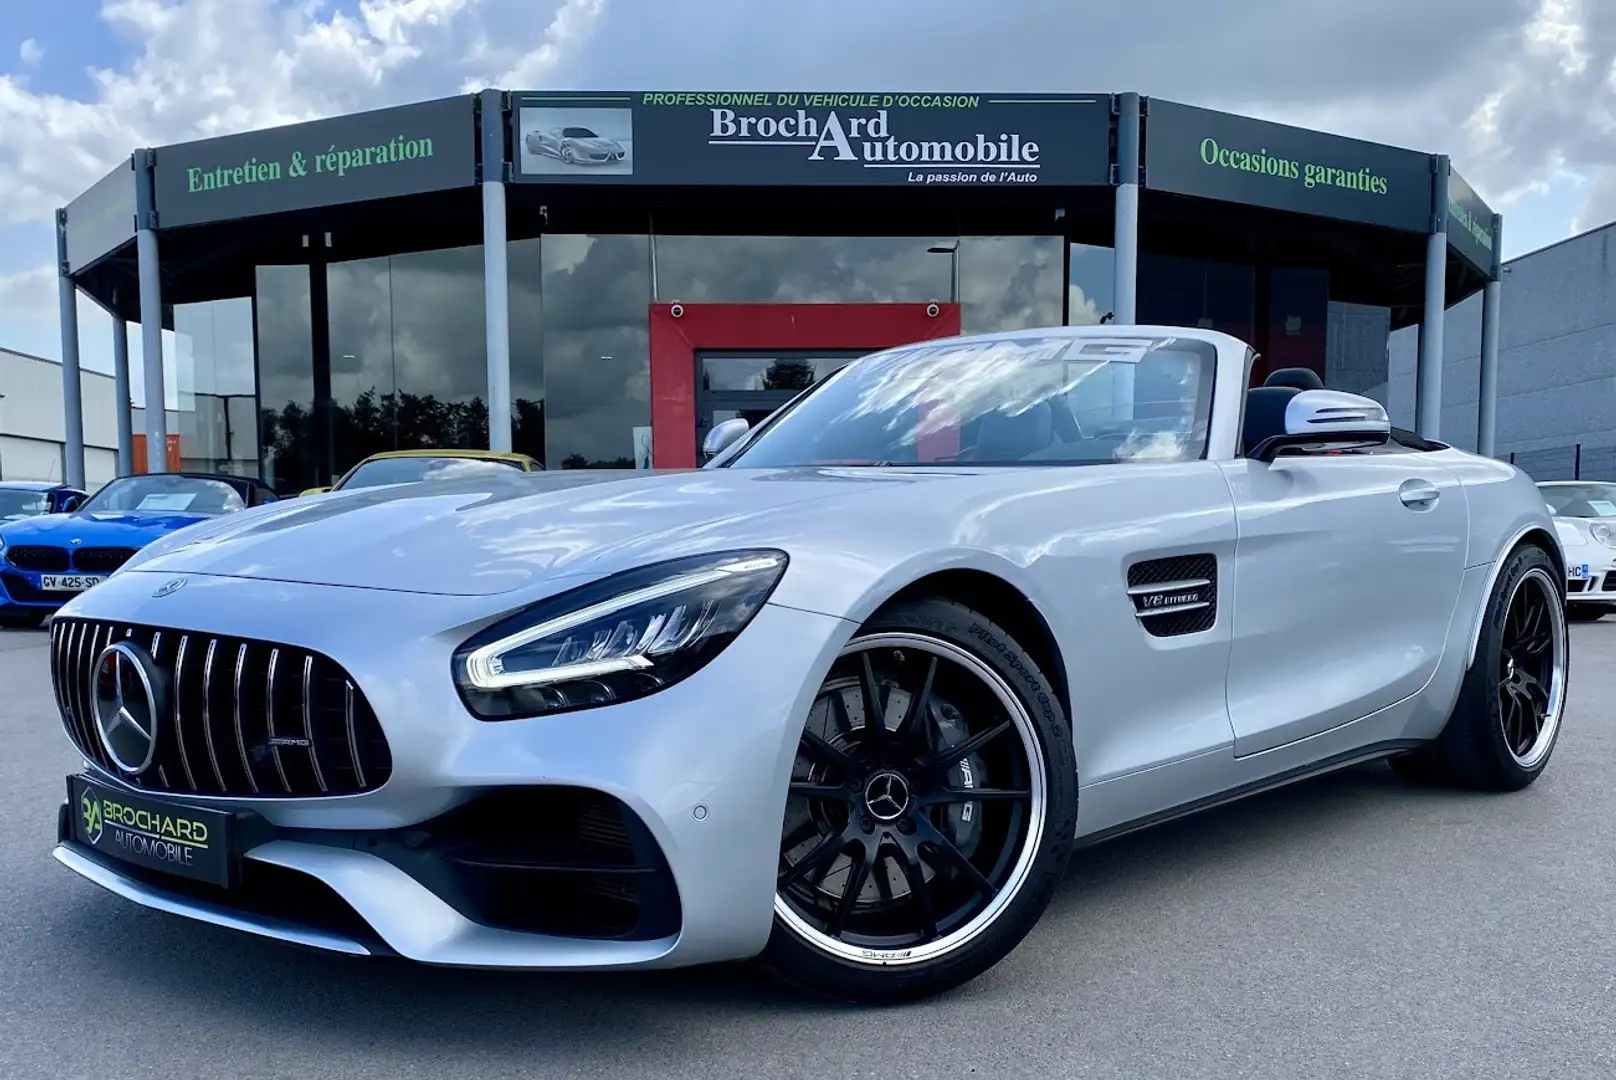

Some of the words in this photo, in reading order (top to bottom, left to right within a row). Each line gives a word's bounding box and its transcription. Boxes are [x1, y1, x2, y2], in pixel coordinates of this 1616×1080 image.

[642, 93, 773, 106] PROFESSIONNEL
[776, 94, 800, 107] DU
[803, 94, 879, 107] VEHICULE
[882, 95, 980, 108] D'OCCASION
[186, 157, 282, 194] Entretien
[288, 151, 309, 178] &
[314, 134, 434, 177] réparation
[907, 172, 924, 183] La
[926, 171, 977, 185] passion
[980, 172, 997, 183] de
[999, 171, 1039, 183] l'Auto
[1200, 137, 1300, 180] Occasions
[1304, 162, 1389, 196] garanties
[1003, 650, 1042, 692] Sport
[103, 800, 208, 841] BROCHARD
[115, 829, 194, 867] AUTOMOBILE
